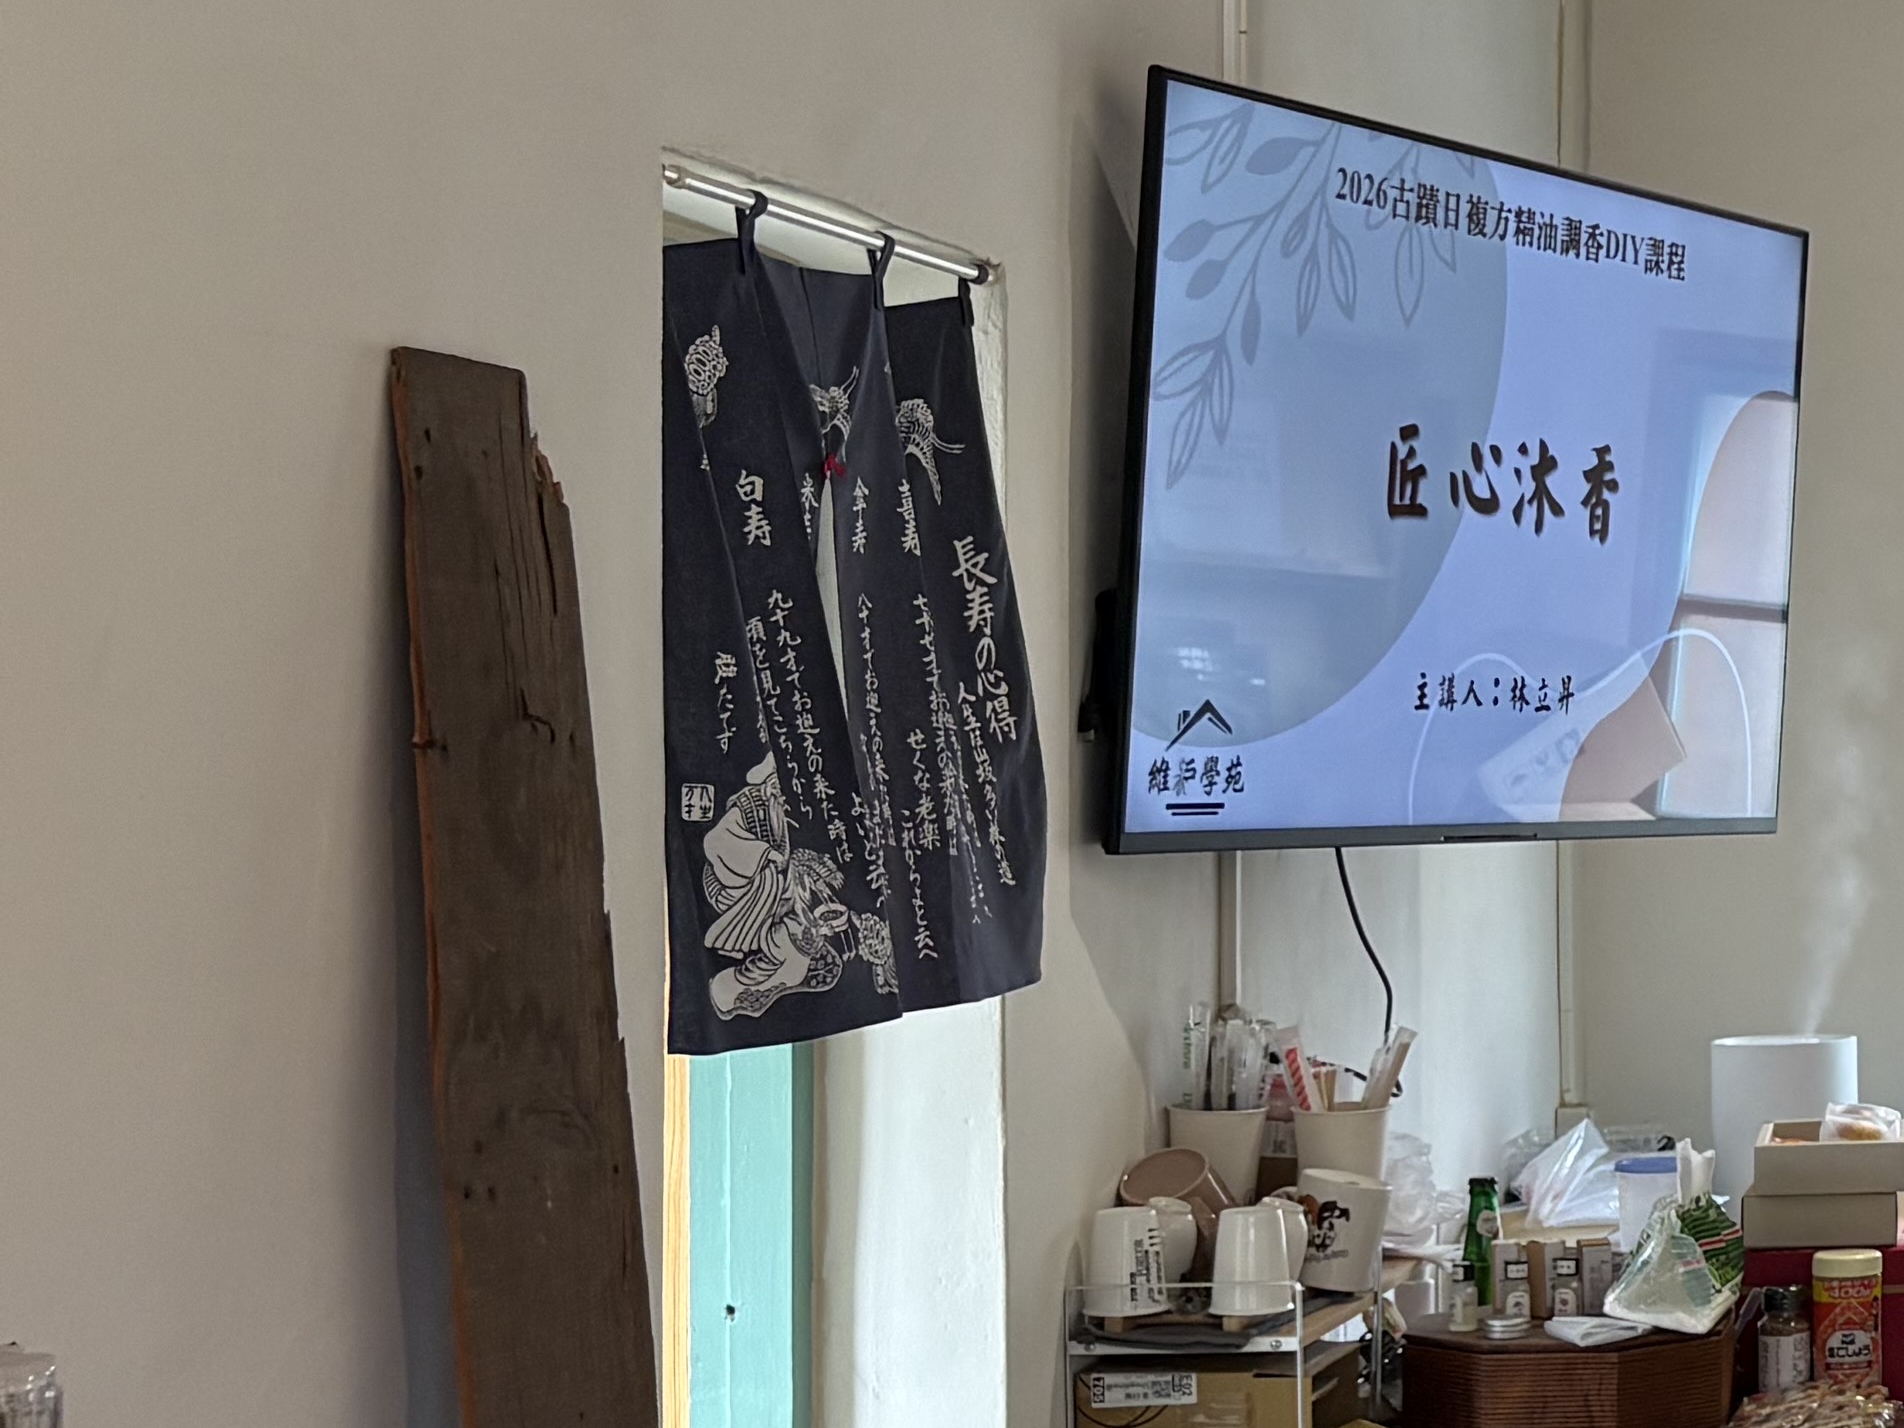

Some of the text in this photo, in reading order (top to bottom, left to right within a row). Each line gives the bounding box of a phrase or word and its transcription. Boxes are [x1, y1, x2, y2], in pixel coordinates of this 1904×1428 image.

[1335, 166, 1688, 282] 2026古蹟日複方精油調香DIY課程
[735, 469, 772, 547] 白寿
[1387, 423, 1619, 546] 匠心沐香
[952, 535, 1018, 744] 長寿の心得
